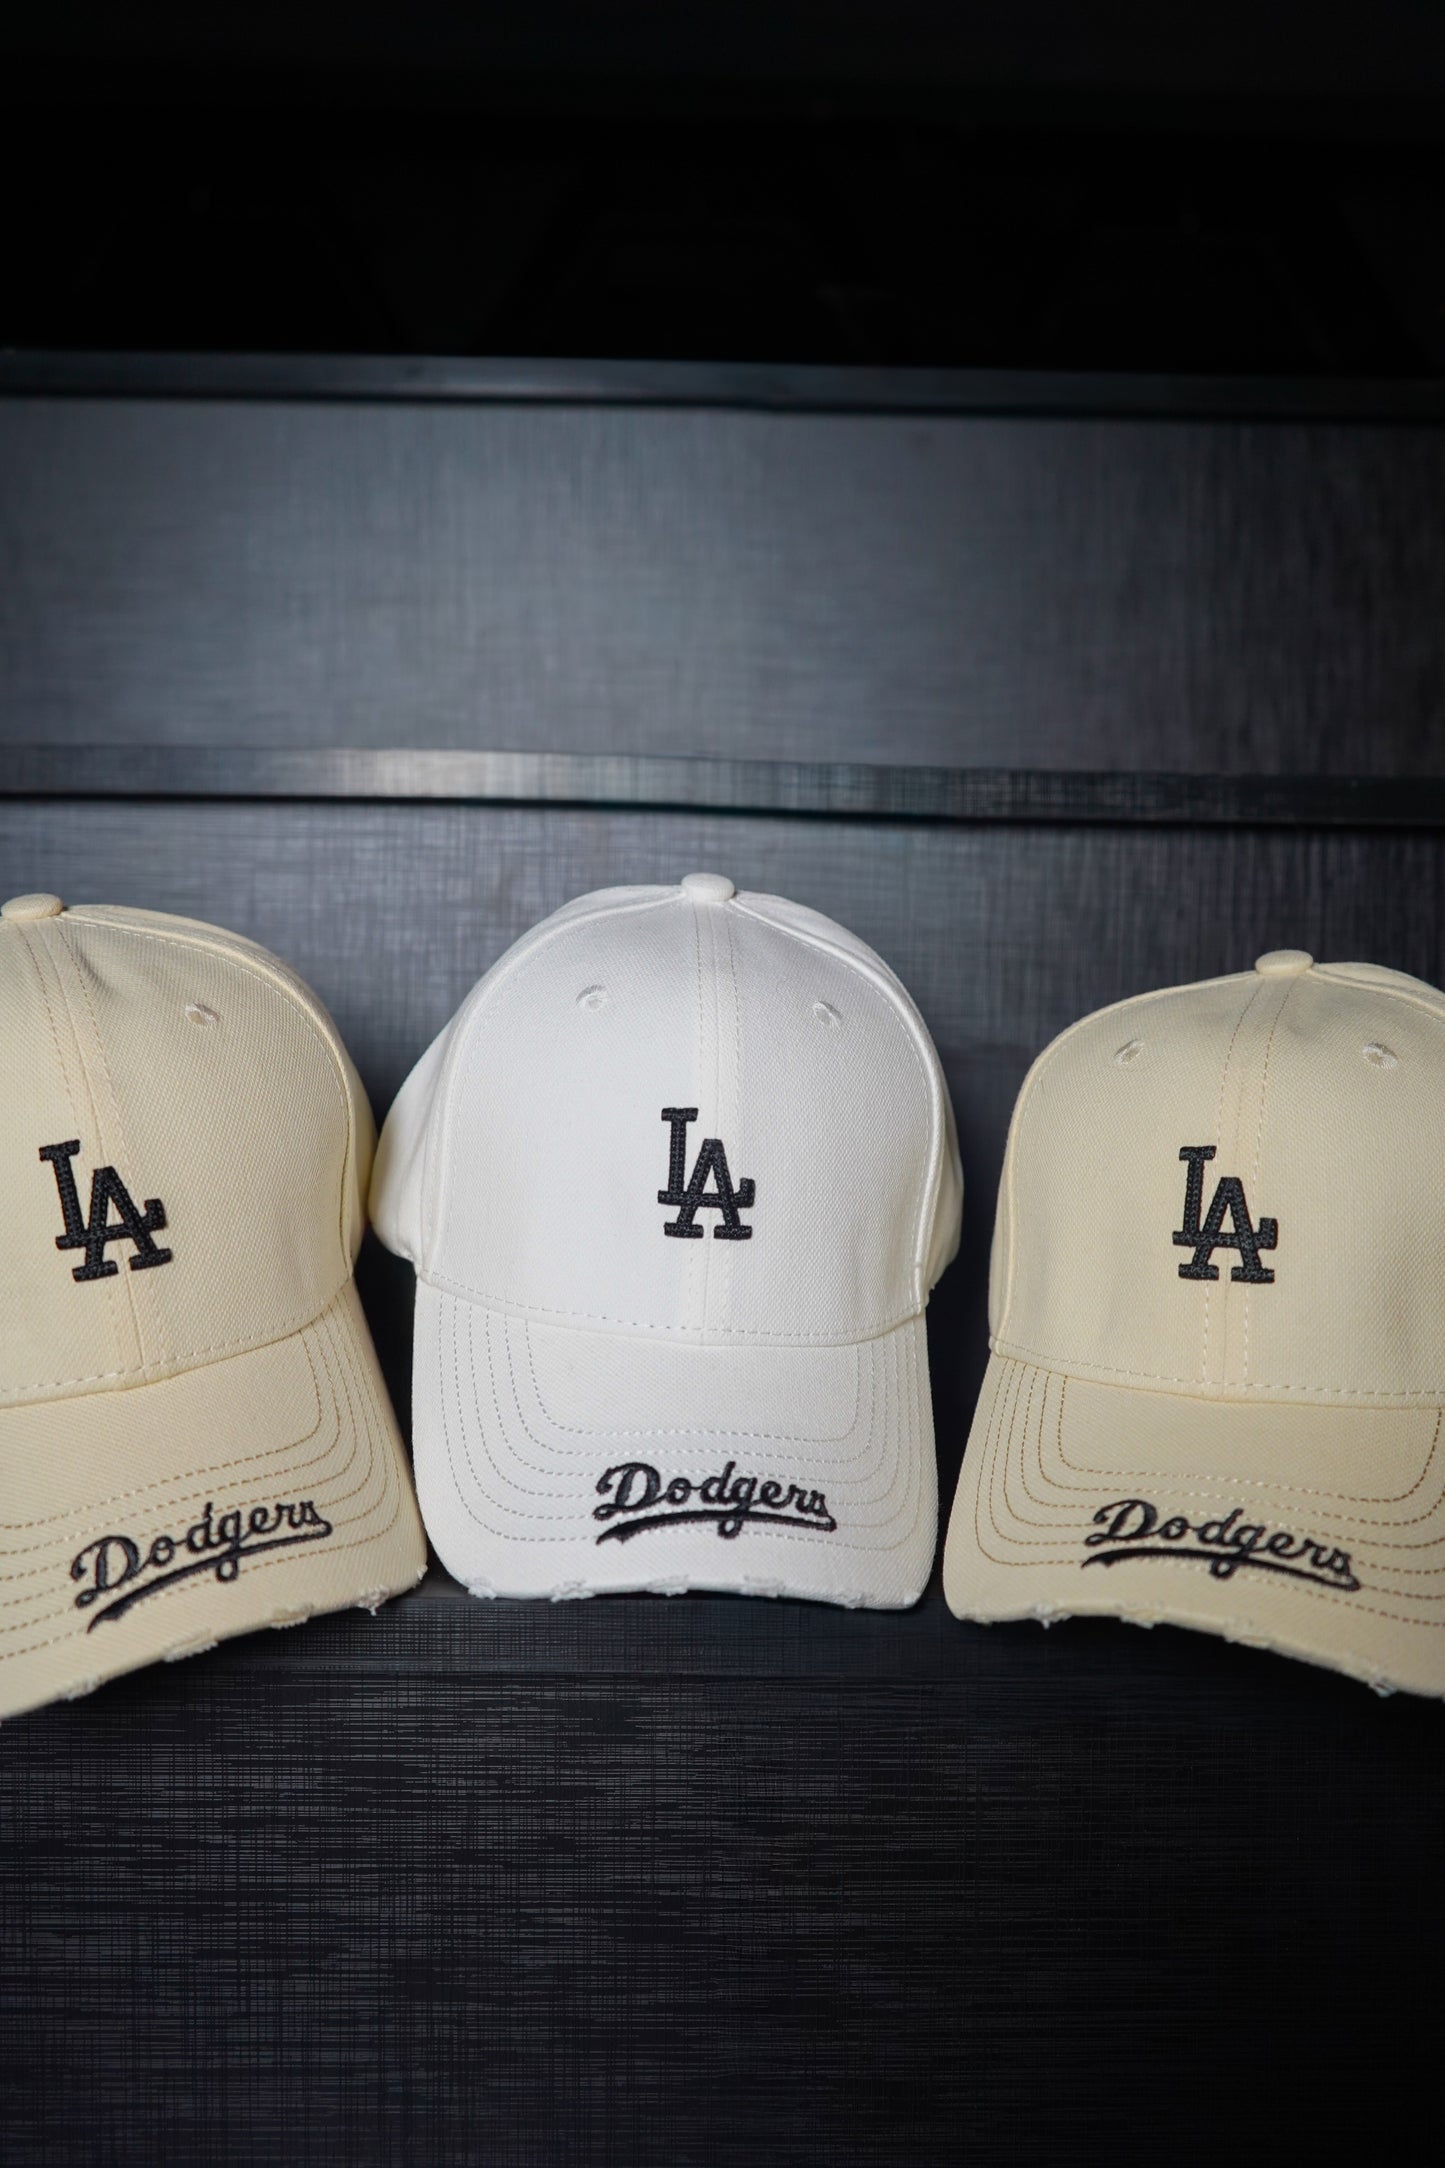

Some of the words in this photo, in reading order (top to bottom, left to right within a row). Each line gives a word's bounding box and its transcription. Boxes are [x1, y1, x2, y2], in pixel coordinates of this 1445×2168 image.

[38, 1138, 174, 1283] LA
[657, 1106, 756, 1241] LA
[1171, 1145, 1279, 1285] LA
[69, 1500, 334, 1635] Dodgers
[592, 1460, 838, 1546] Dodgers
[1080, 1498, 1365, 1594] Dodgers
